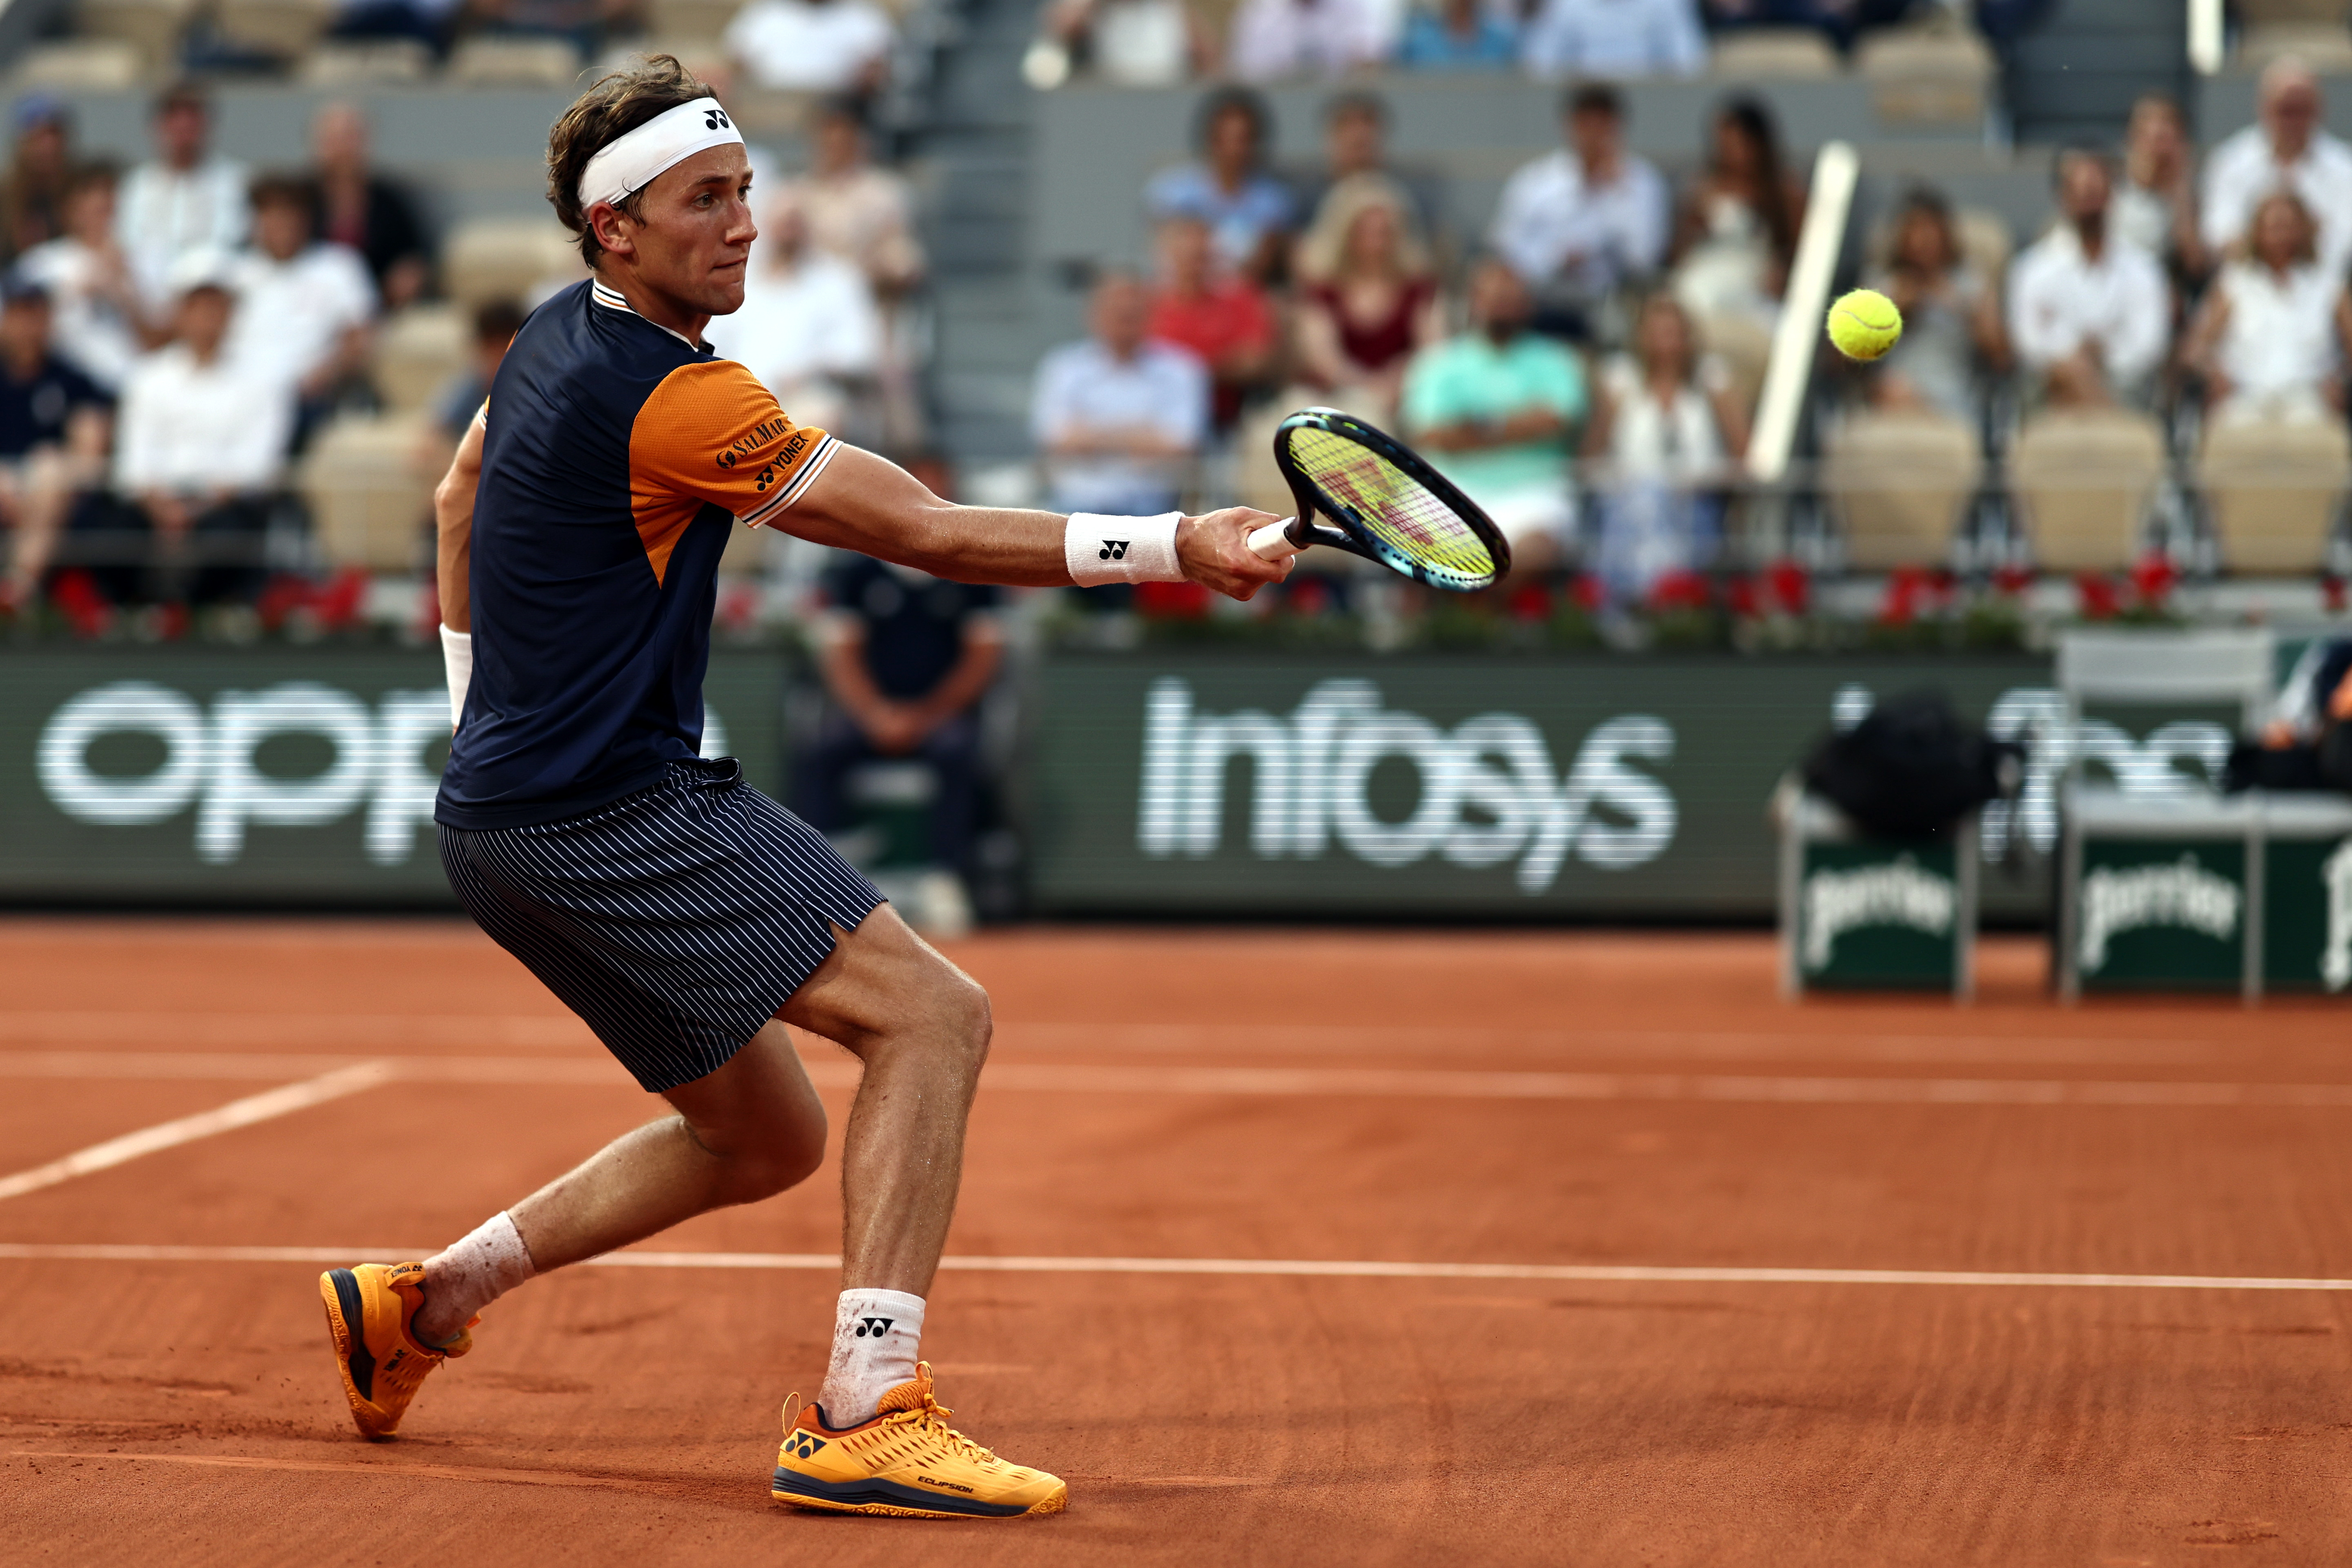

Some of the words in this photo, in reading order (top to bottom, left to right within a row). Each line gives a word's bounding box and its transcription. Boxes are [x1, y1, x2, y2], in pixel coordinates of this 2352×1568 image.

[771, 431, 810, 470] YONEX
[35, 680, 728, 867] opp
[1137, 675, 1679, 896] Infosys
[917, 1475, 974, 1493] ECLIPSION
